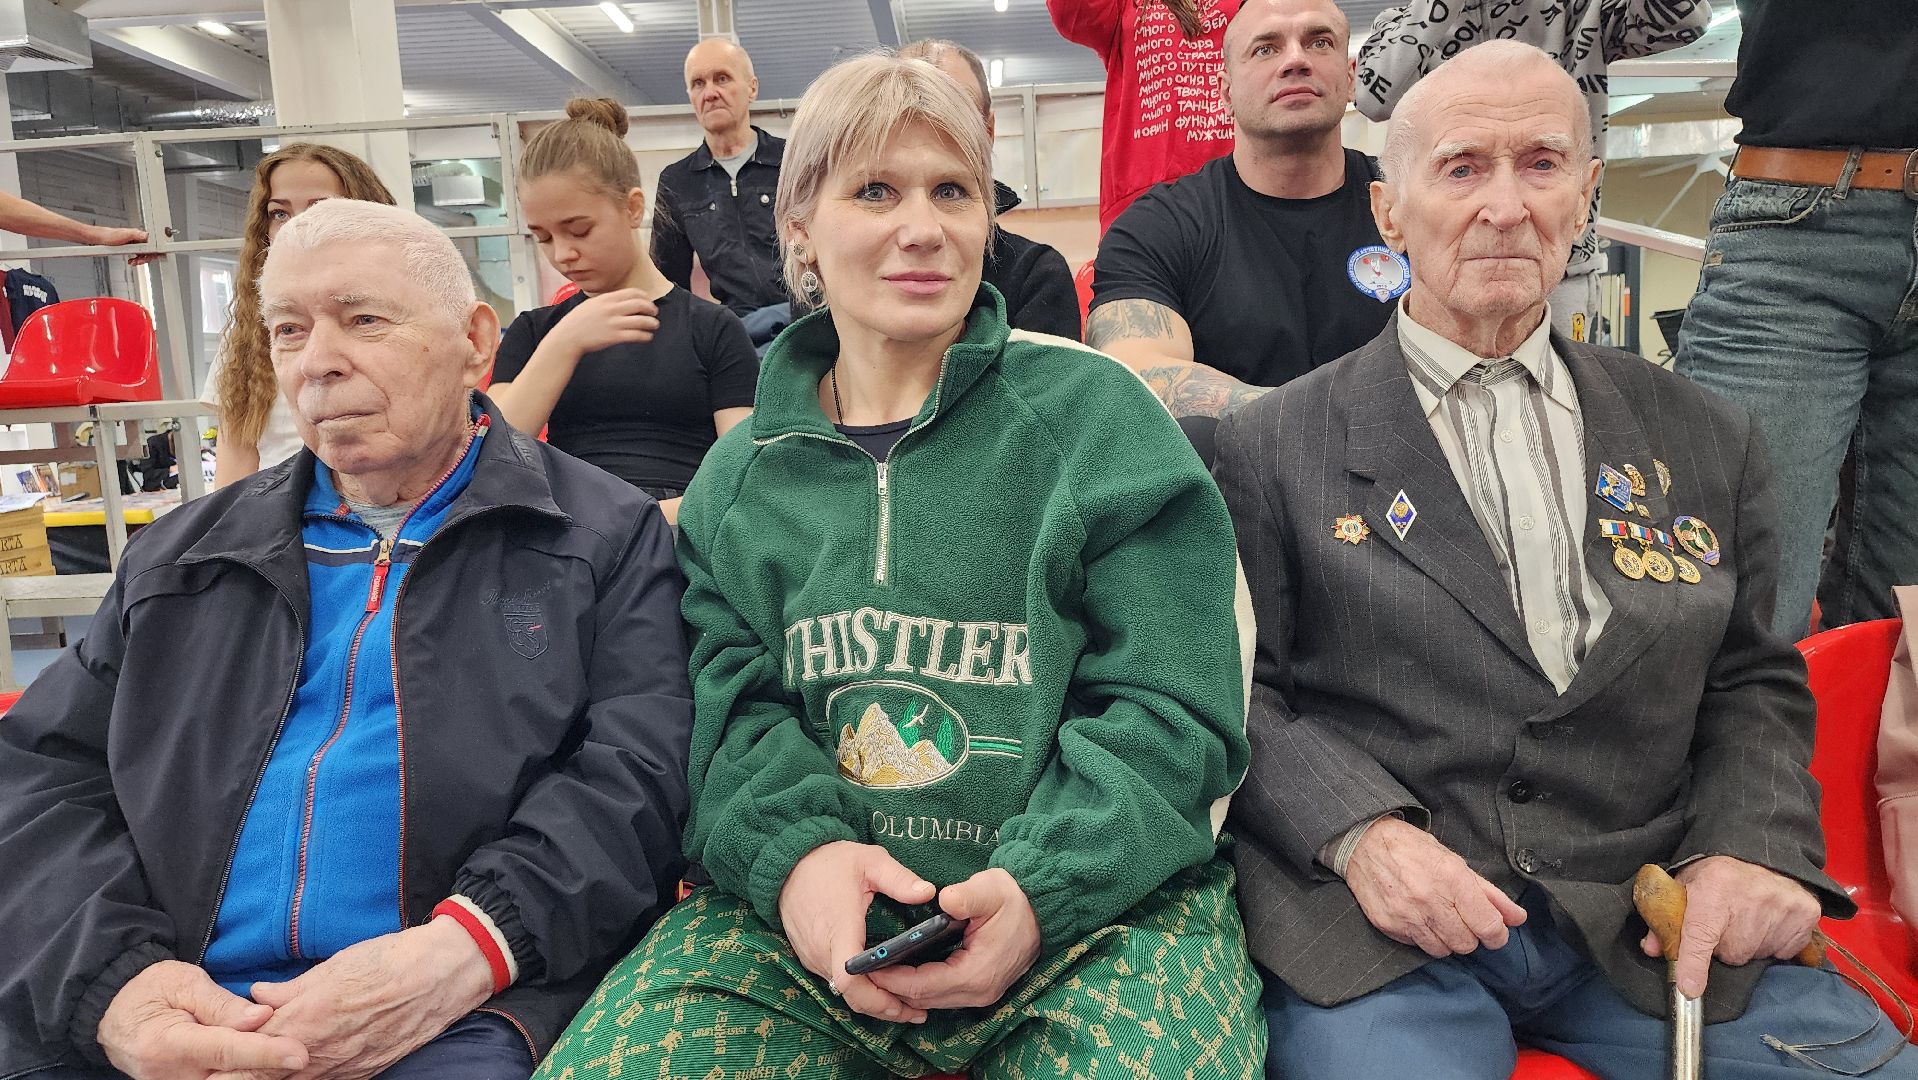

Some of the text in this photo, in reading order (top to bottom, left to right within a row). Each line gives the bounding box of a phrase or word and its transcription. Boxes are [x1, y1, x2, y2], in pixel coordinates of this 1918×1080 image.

[1200, 13, 1228, 34] ЗЕЙ
[1134, 38, 1173, 57] МНОГО
[1136, 52, 1173, 71] МНОГО
[1138, 61, 1178, 84] МНОГО
[1138, 76, 1173, 98] МНОГО
[1174, 74, 1205, 86] ОГНЯ
[1140, 91, 1171, 110] МНОГО
[1141, 103, 1172, 123] МНОГО
[784, 606, 1034, 688] HISTLER
[871, 809, 1000, 848] OLUMBIA
